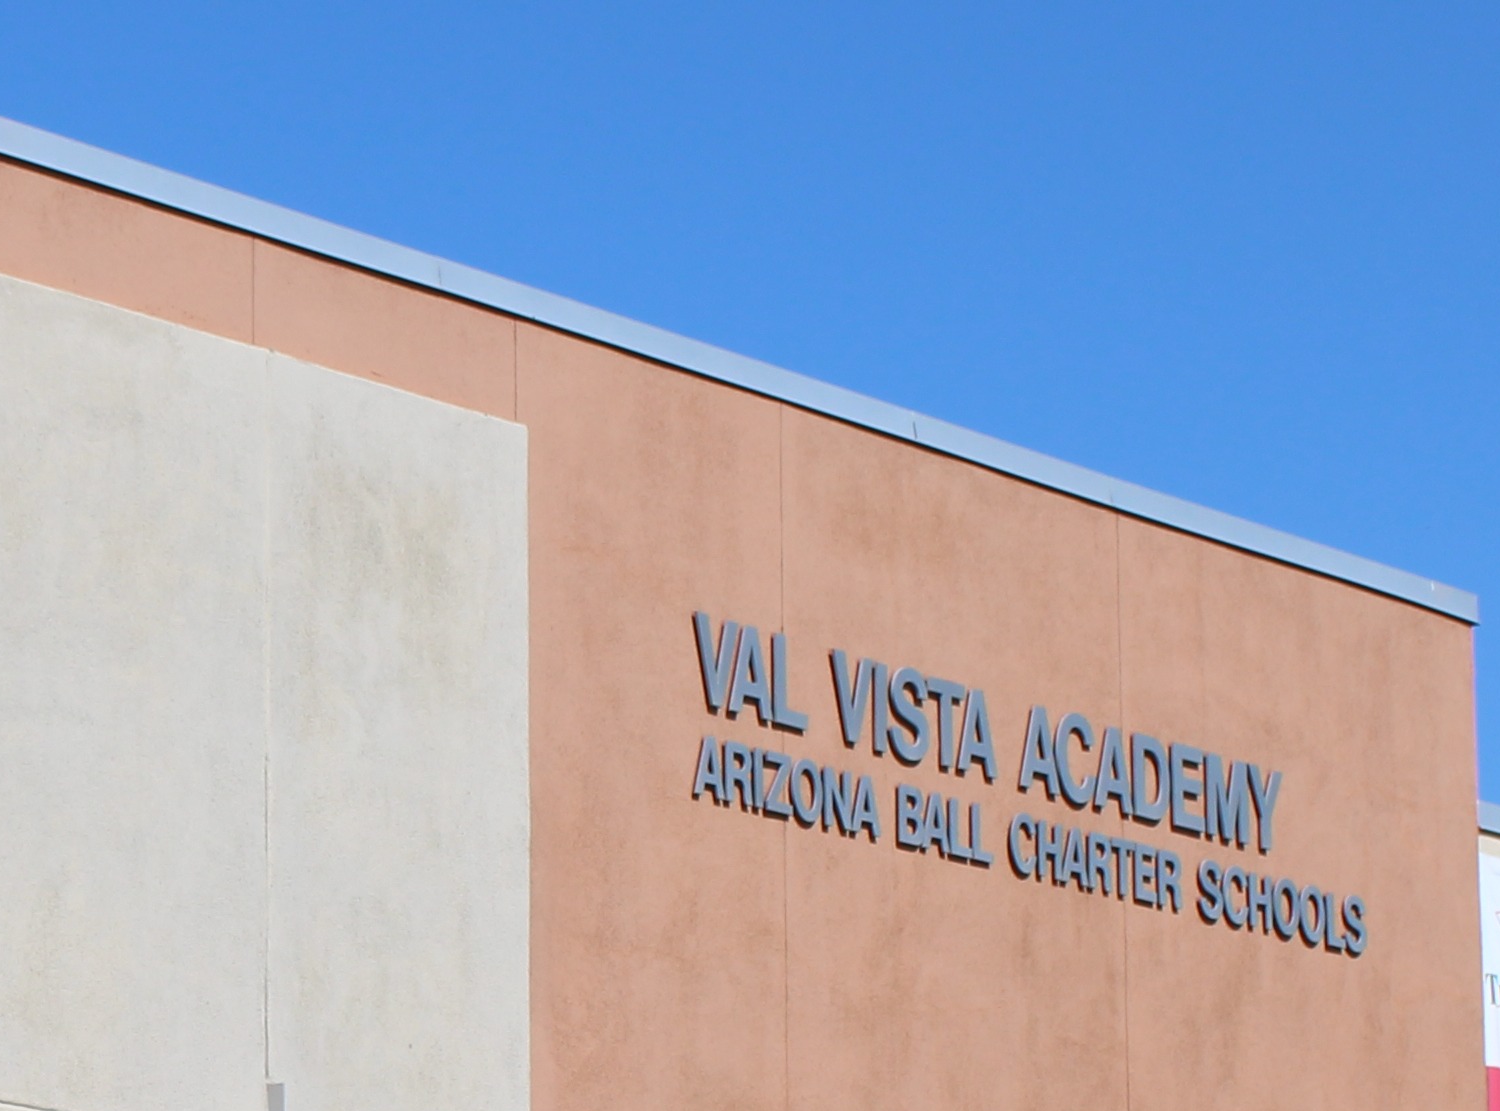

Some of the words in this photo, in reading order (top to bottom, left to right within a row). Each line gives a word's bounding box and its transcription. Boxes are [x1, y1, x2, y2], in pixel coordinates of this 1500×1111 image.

[691, 610, 810, 736] VAL
[828, 648, 999, 784] VISTA
[1018, 705, 1284, 854] ACADEMY
[691, 736, 882, 842] ARIZONA
[896, 785, 994, 869] BALL
[1007, 812, 1184, 915] CHARTER
[1196, 859, 1368, 958] SCHOOLS
